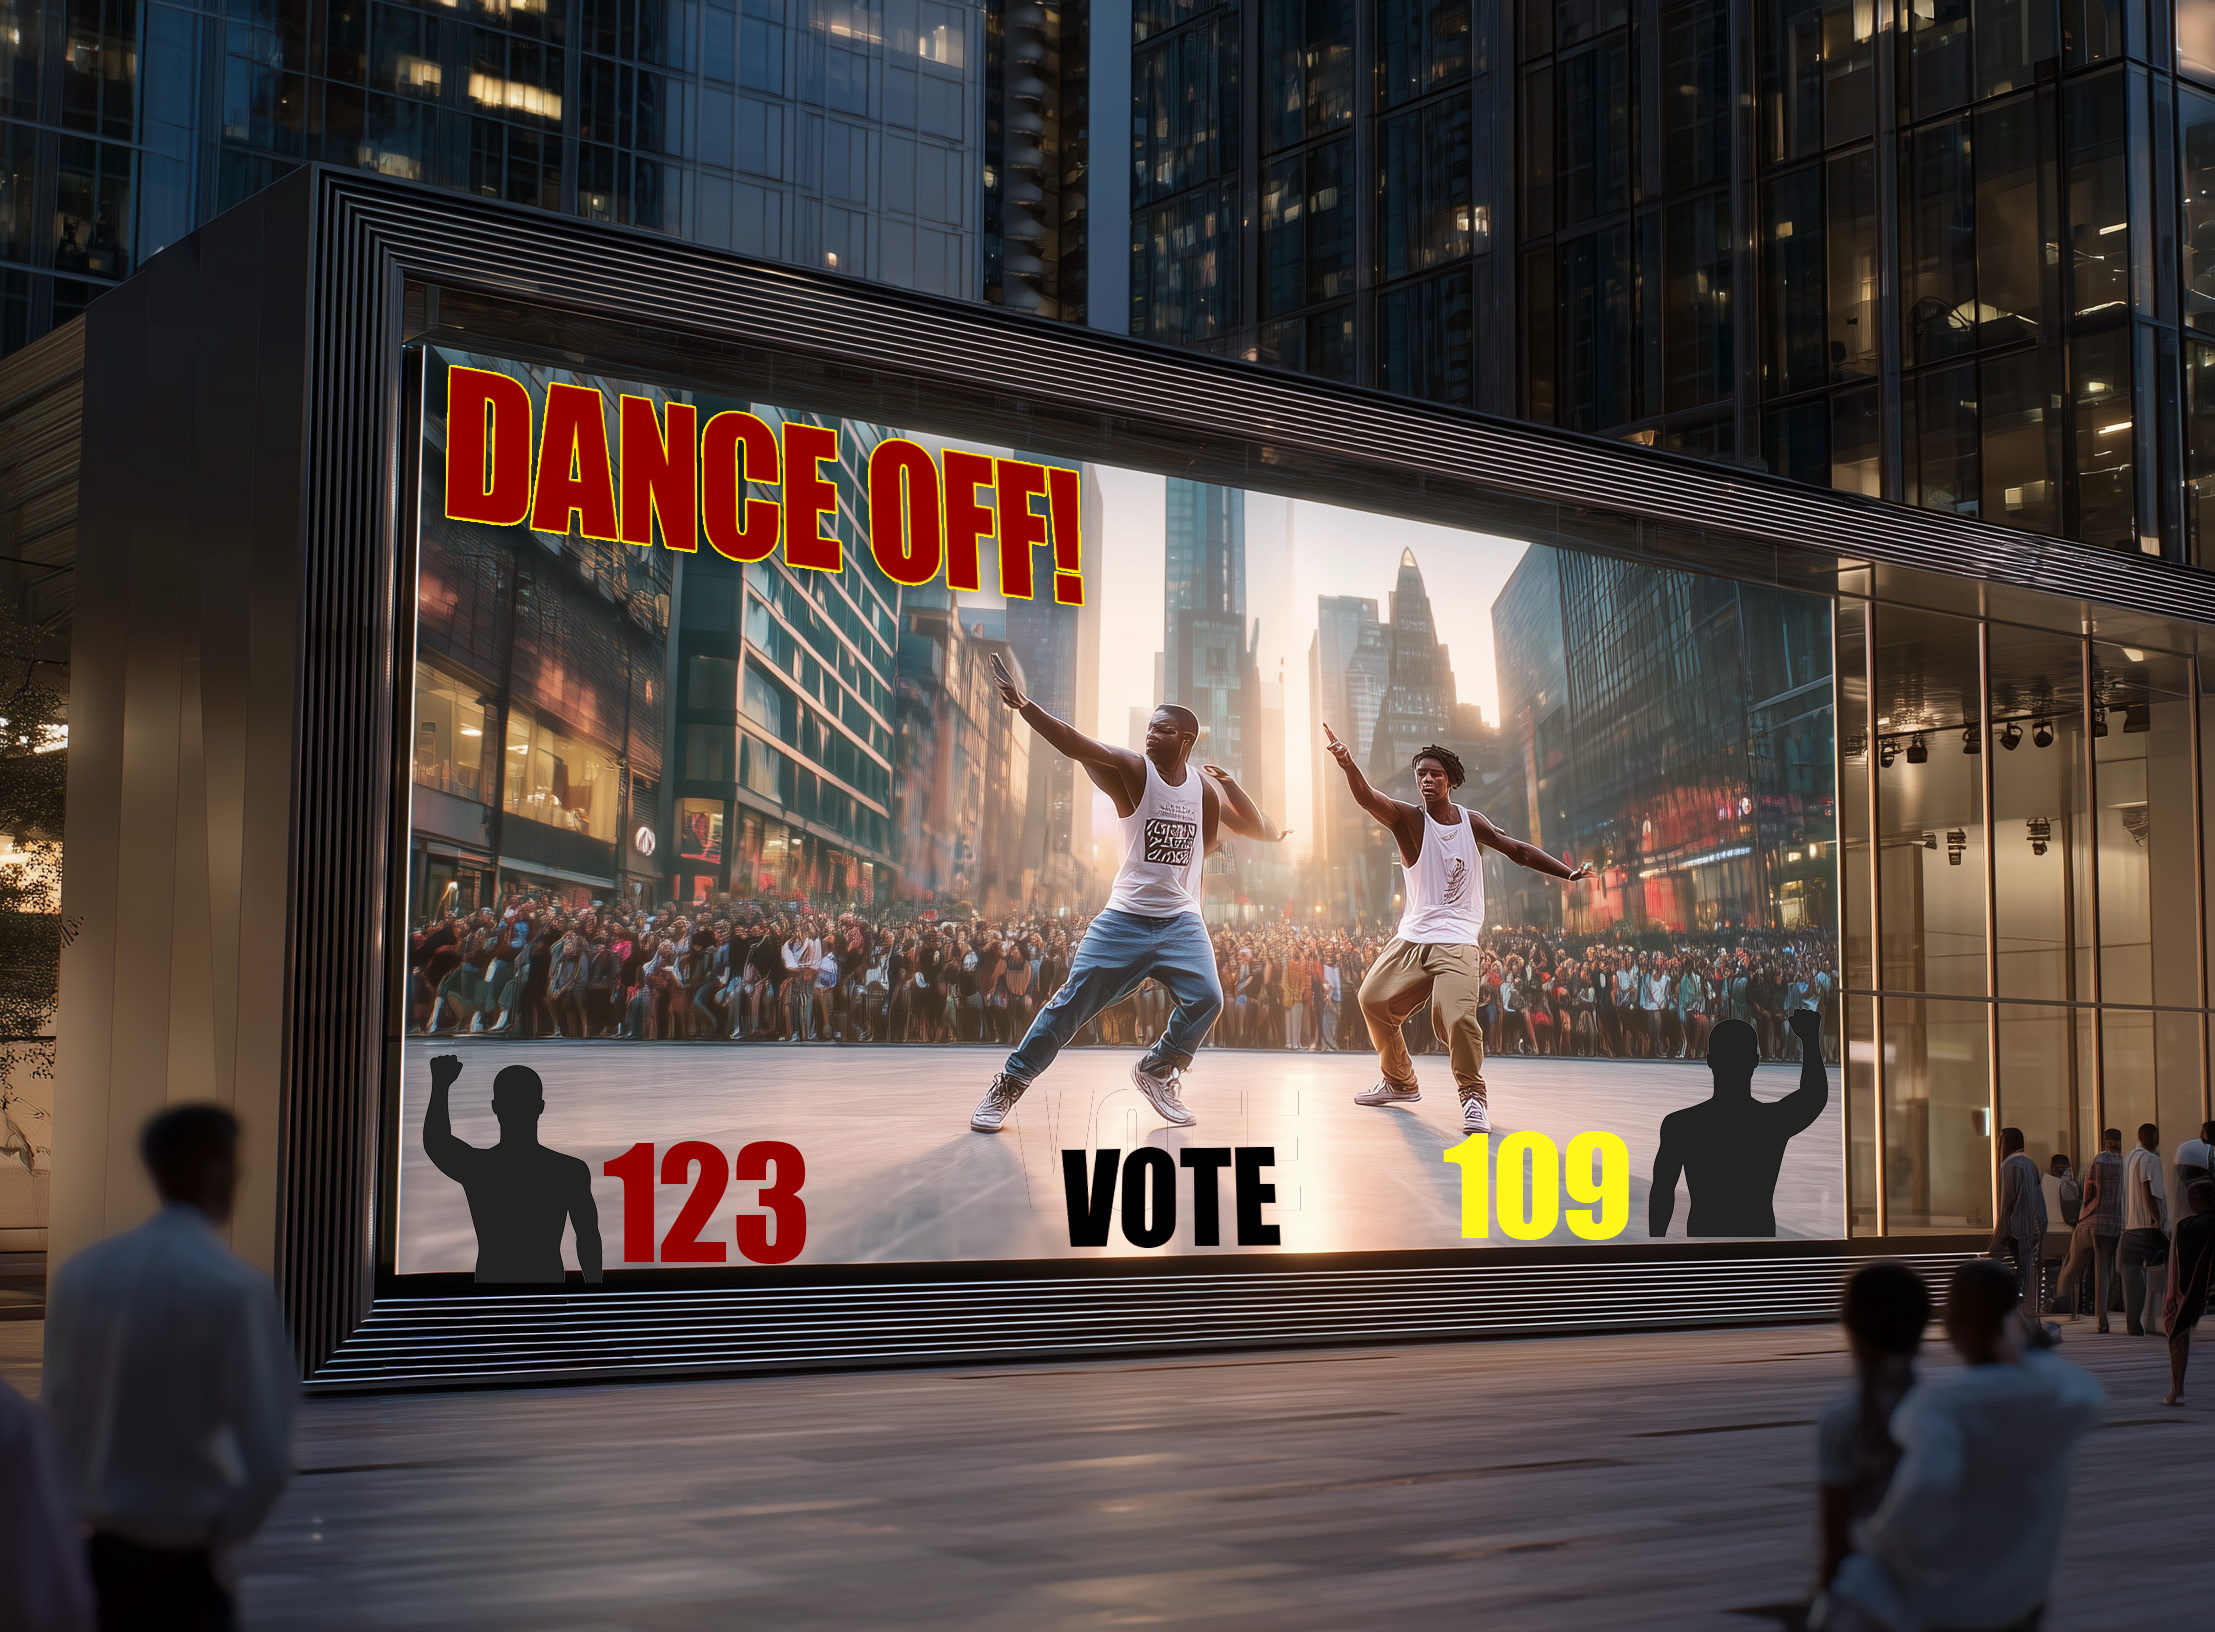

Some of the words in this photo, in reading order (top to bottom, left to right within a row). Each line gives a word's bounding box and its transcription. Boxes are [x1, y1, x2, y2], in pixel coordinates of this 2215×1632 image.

[445, 365, 843, 573] DANCE
[868, 438, 1085, 606] OFF!
[604, 1141, 806, 1264] 123
[1062, 1147, 1280, 1248] VOTE
[1444, 1131, 1629, 1240] 109
